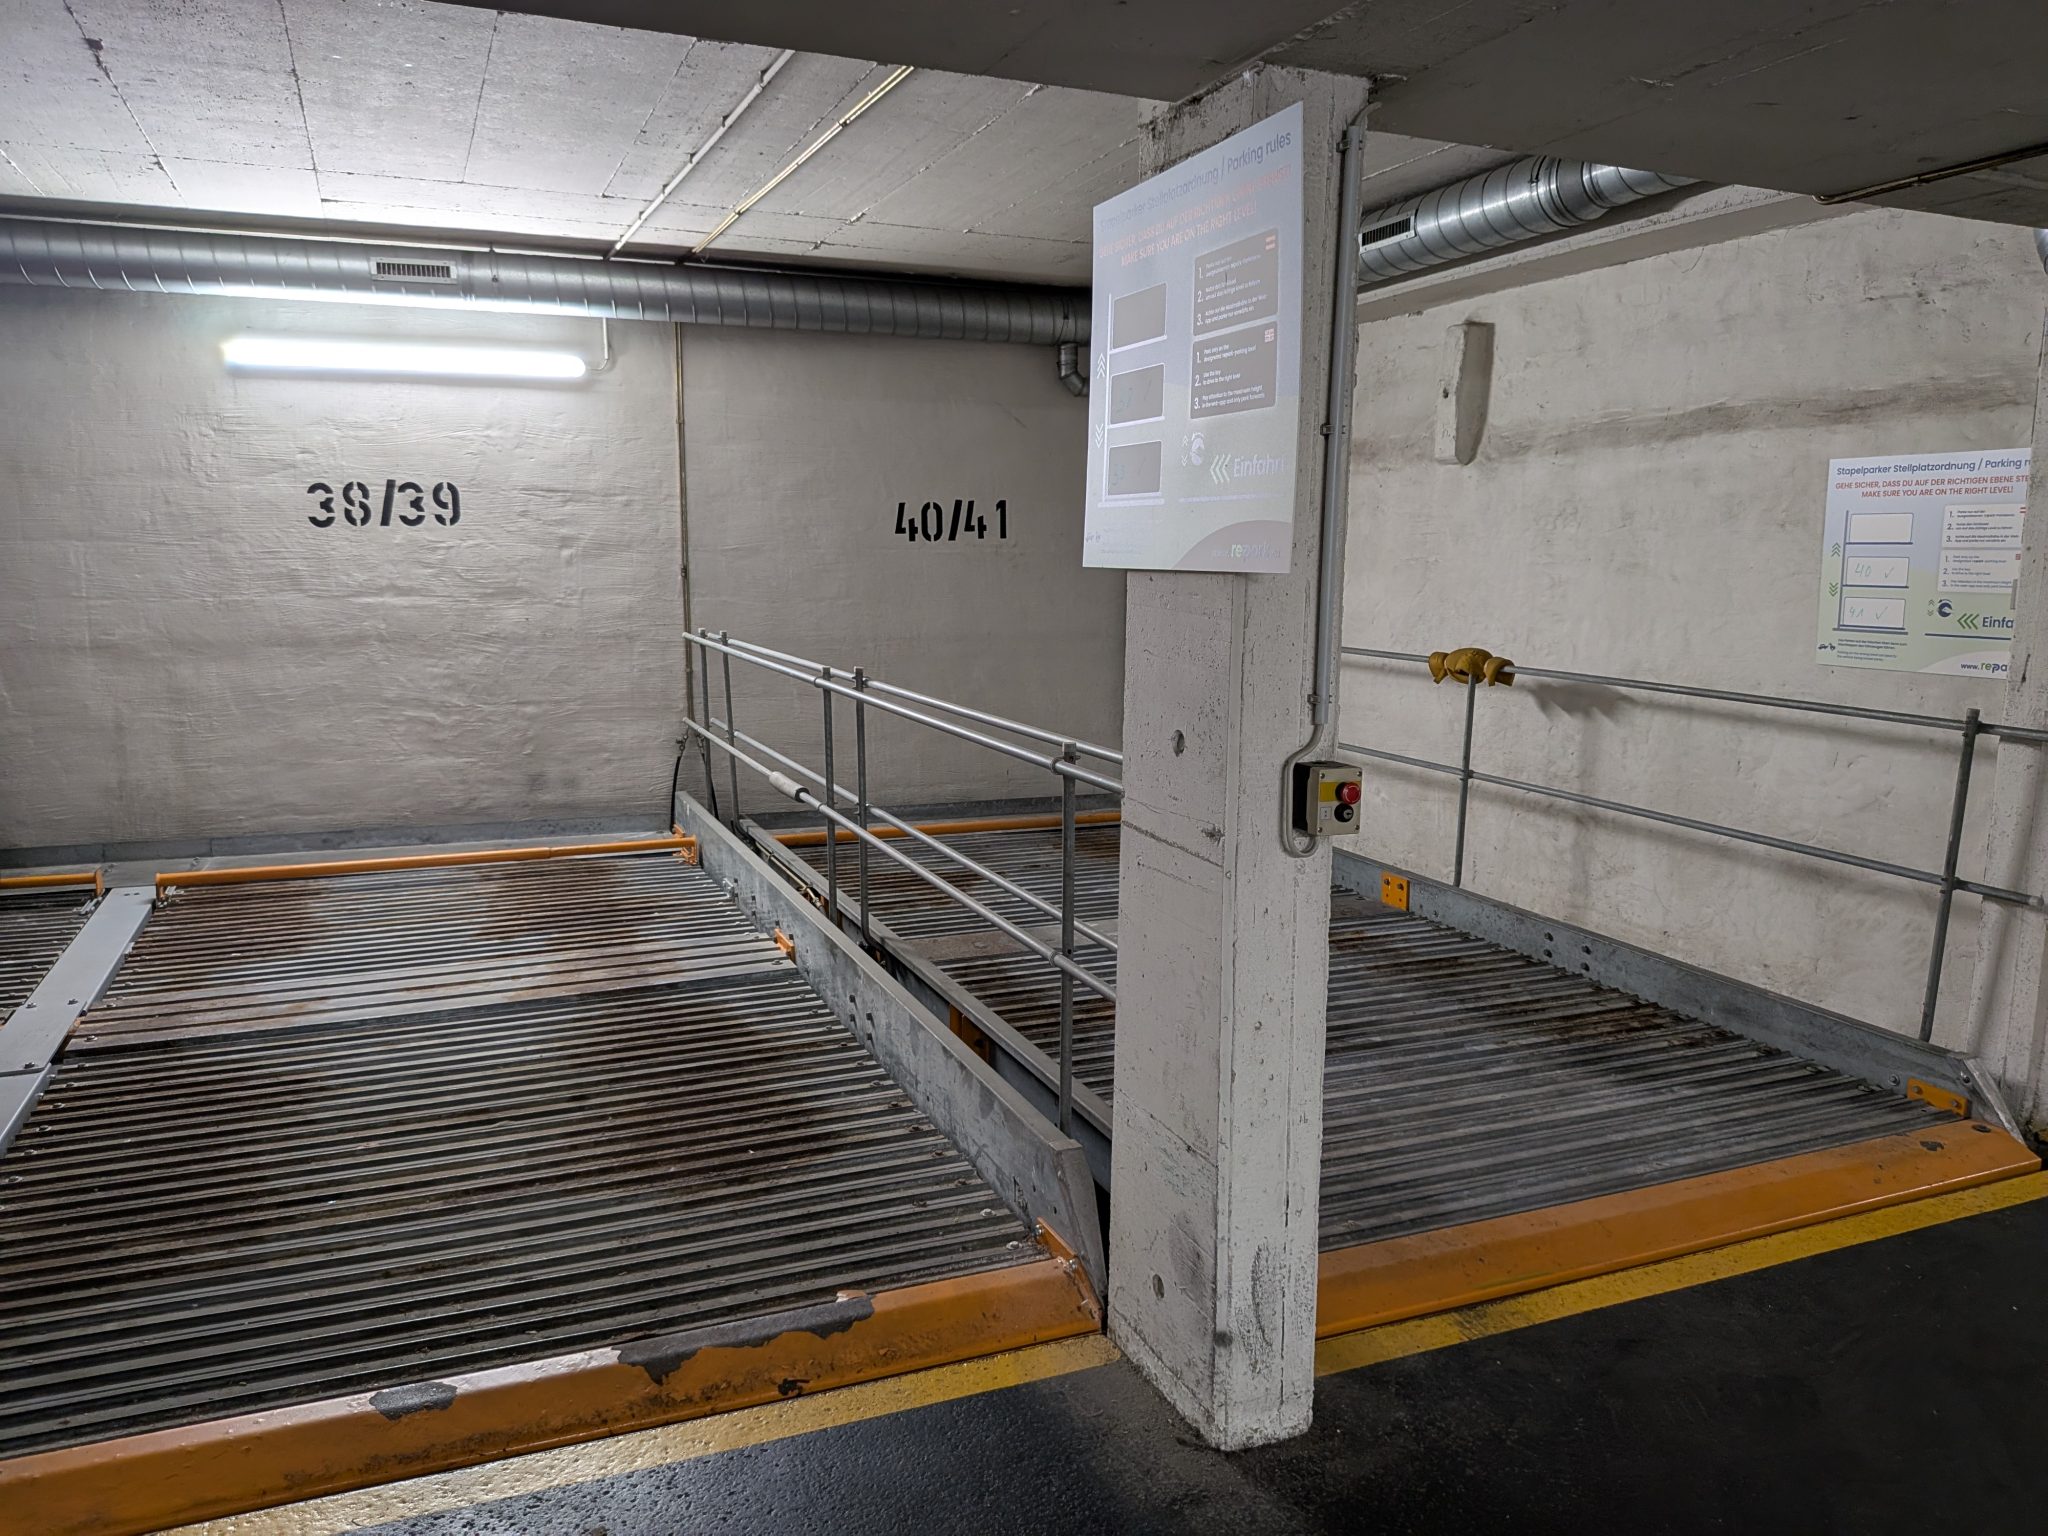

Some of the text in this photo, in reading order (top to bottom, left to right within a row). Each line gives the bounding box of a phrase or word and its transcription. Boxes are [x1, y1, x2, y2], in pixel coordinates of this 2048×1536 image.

[1227, 146, 1264, 174] Parking
[1265, 132, 1291, 154] rules
[1156, 237, 1169, 252] YOU
[1836, 465, 1892, 477] Stapelparker
[1893, 461, 1976, 475] Stellplatzordnung
[1985, 458, 2022, 470] Parking
[1835, 482, 1853, 490] GEHE
[1854, 480, 1880, 489] SICHER,
[1882, 480, 1901, 488] DASS
[1902, 479, 1913, 487] DU
[1914, 478, 1930, 486] AUF
[1931, 478, 1946, 486] DER
[1947, 476, 1988, 485] RICHTIGEN
[1989, 475, 2014, 484] EBENE
[1861, 490, 1881, 498] MAKE
[1882, 489, 1901, 497] SURE
[1918, 488, 1934, 496] ARE
[1935, 488, 1947, 496] ON
[1949, 487, 1962, 495] THE
[1964, 486, 1988, 494] RIGHT
[1989, 486, 2014, 494] LEVEL!
[306, 479, 461, 529] 38/39
[894, 499, 1008, 542] 40/41
[1854, 562, 1873, 577] 40
